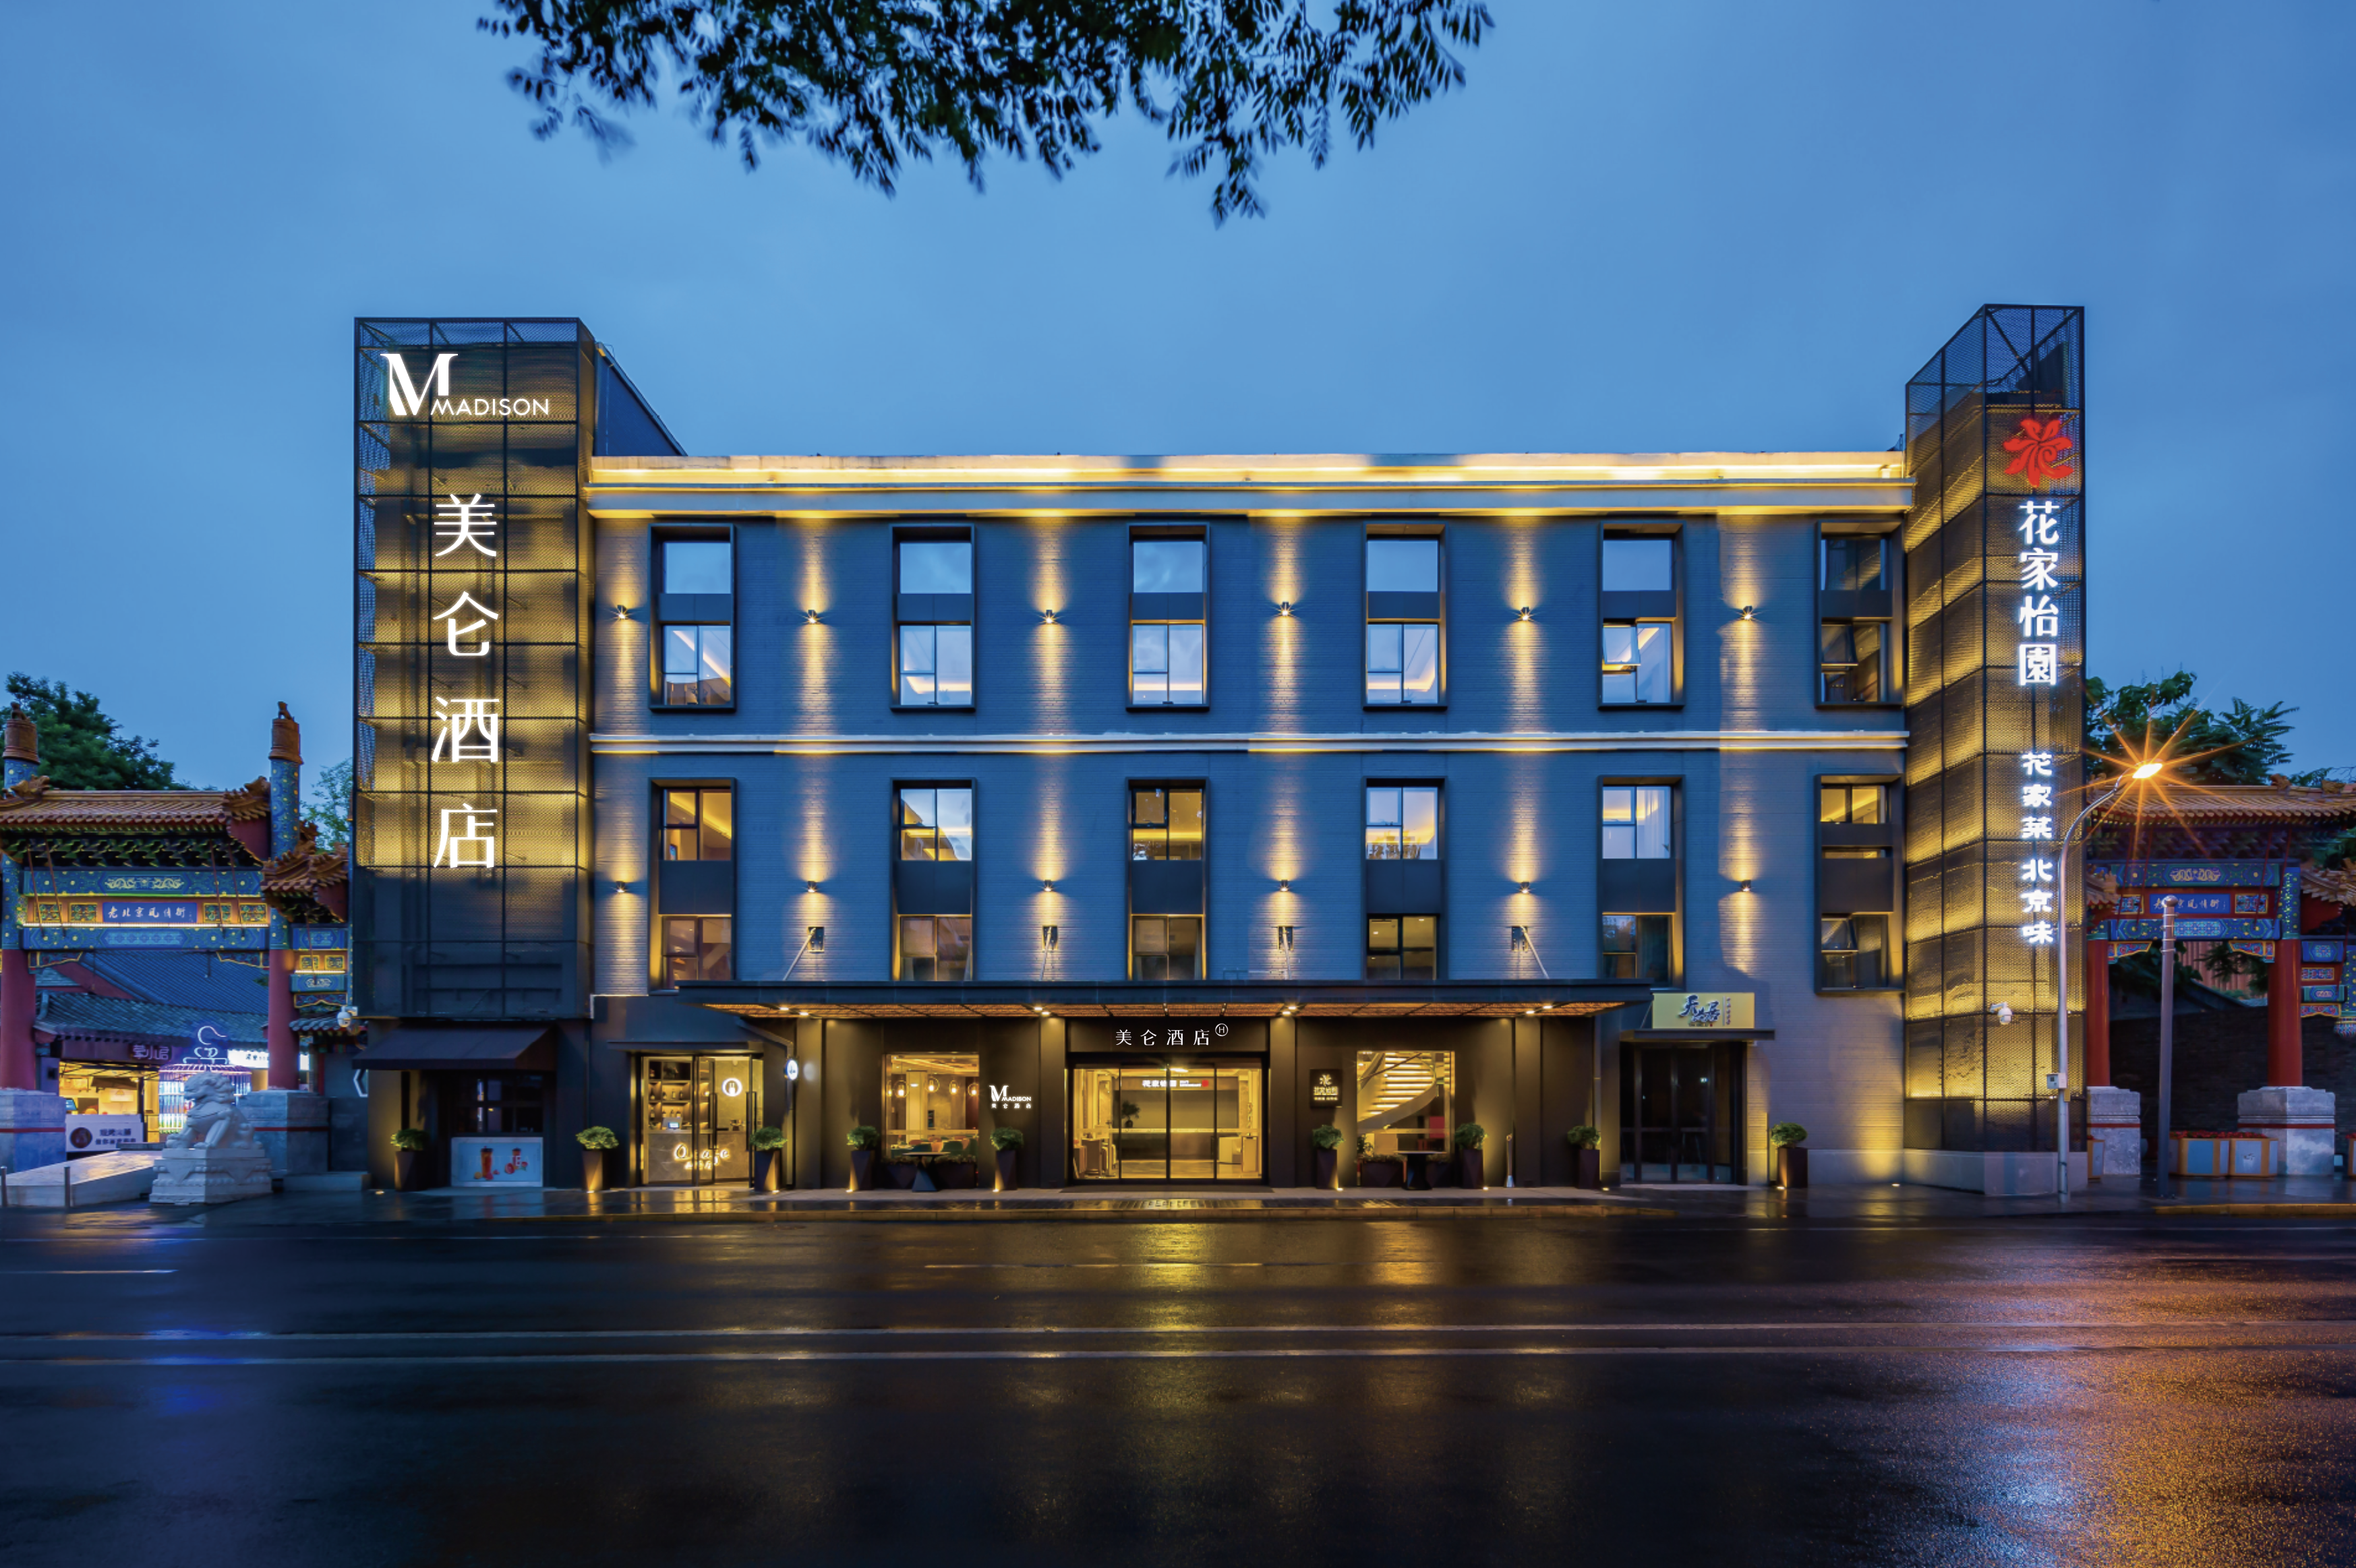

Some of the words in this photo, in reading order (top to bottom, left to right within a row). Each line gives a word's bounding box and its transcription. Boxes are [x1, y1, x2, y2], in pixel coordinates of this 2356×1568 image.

[430, 398, 549, 416] MADISON
[2018, 500, 2060, 686] 花家怡園
[431, 493, 500, 869] 美仑酒店
[1115, 1029, 1210, 1046] 美仑酒店
